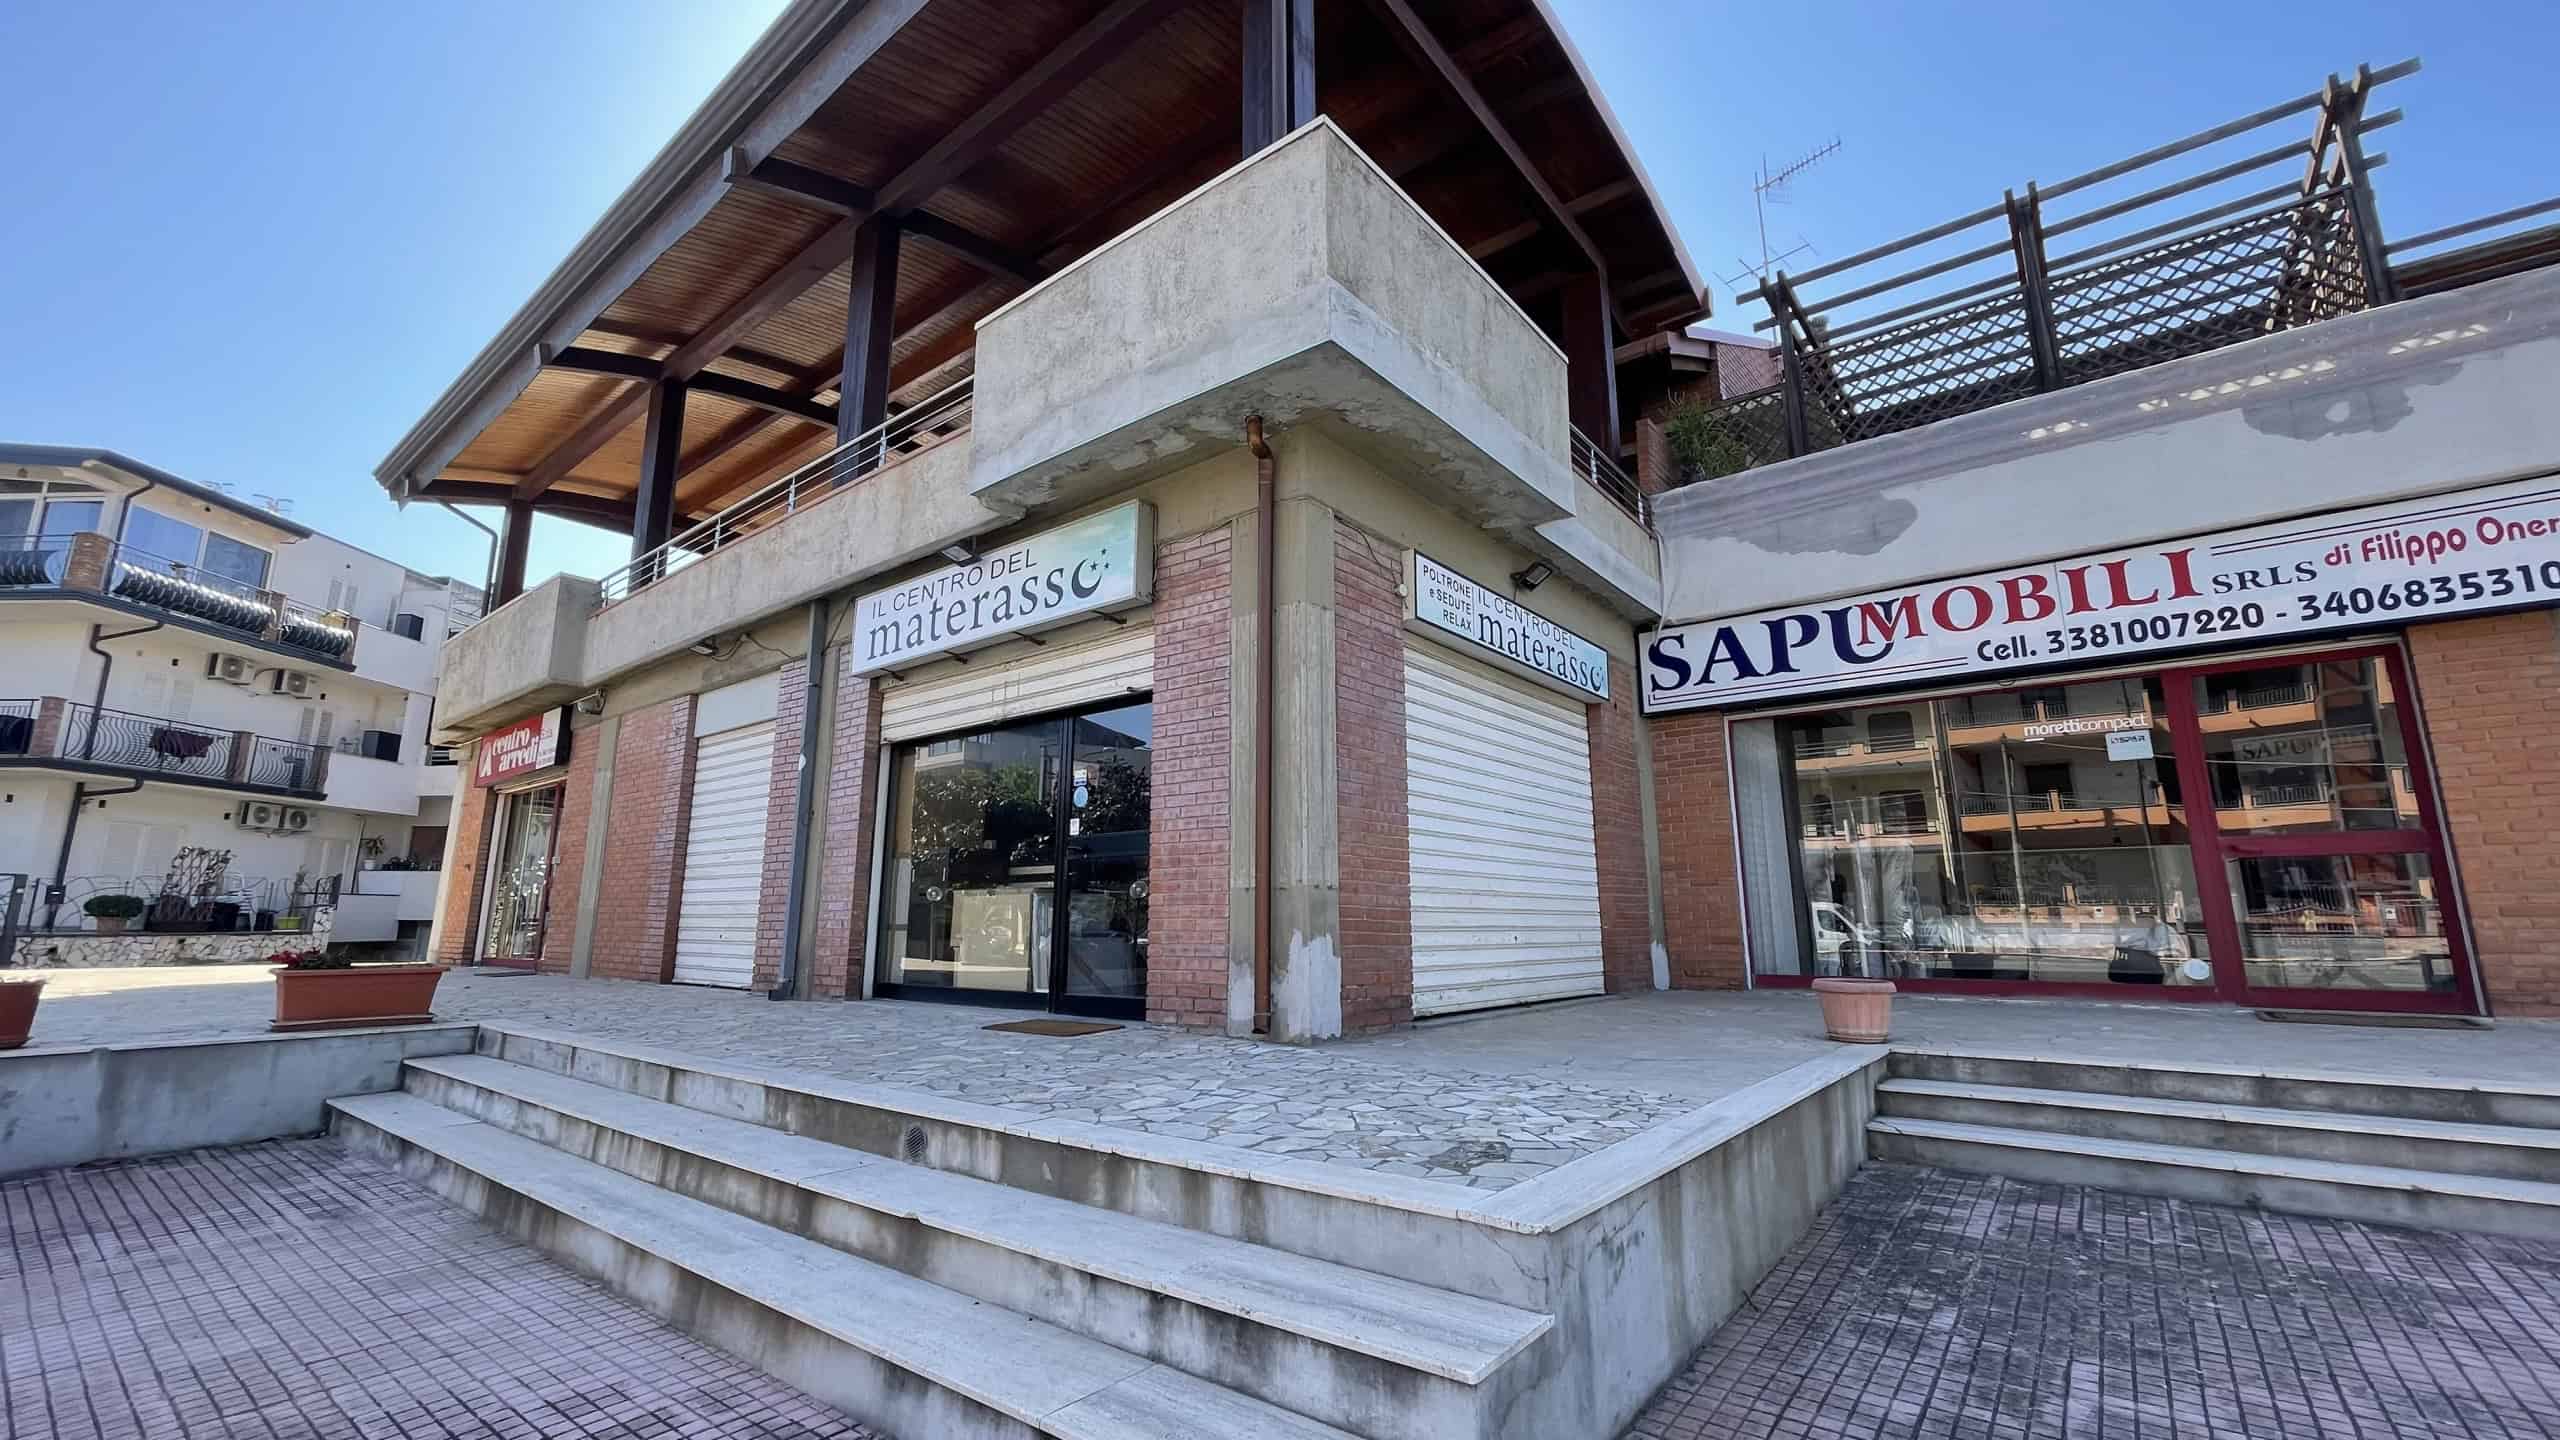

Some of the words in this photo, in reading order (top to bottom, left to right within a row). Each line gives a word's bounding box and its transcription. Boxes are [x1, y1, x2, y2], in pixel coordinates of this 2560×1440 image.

[2324, 543, 2351, 567] di
[2361, 527, 2466, 566] Filippo
[872, 601, 886, 619] IL
[893, 565, 983, 611] CENTRO
[991, 548, 1037, 581] DEL
[1423, 565, 1472, 598] POLTRONE
[2212, 560, 2318, 594] SRLS
[1429, 588, 1435, 598] e
[1436, 591, 1472, 615] SEDUTE
[1478, 587, 1490, 609] IL
[1494, 597, 1551, 636] CENTRO
[1553, 628, 1576, 650] DEL
[1443, 609, 1472, 632] RELAX
[1977, 634, 2037, 663] Cell.
[2047, 603, 2264, 654] 3381007220
